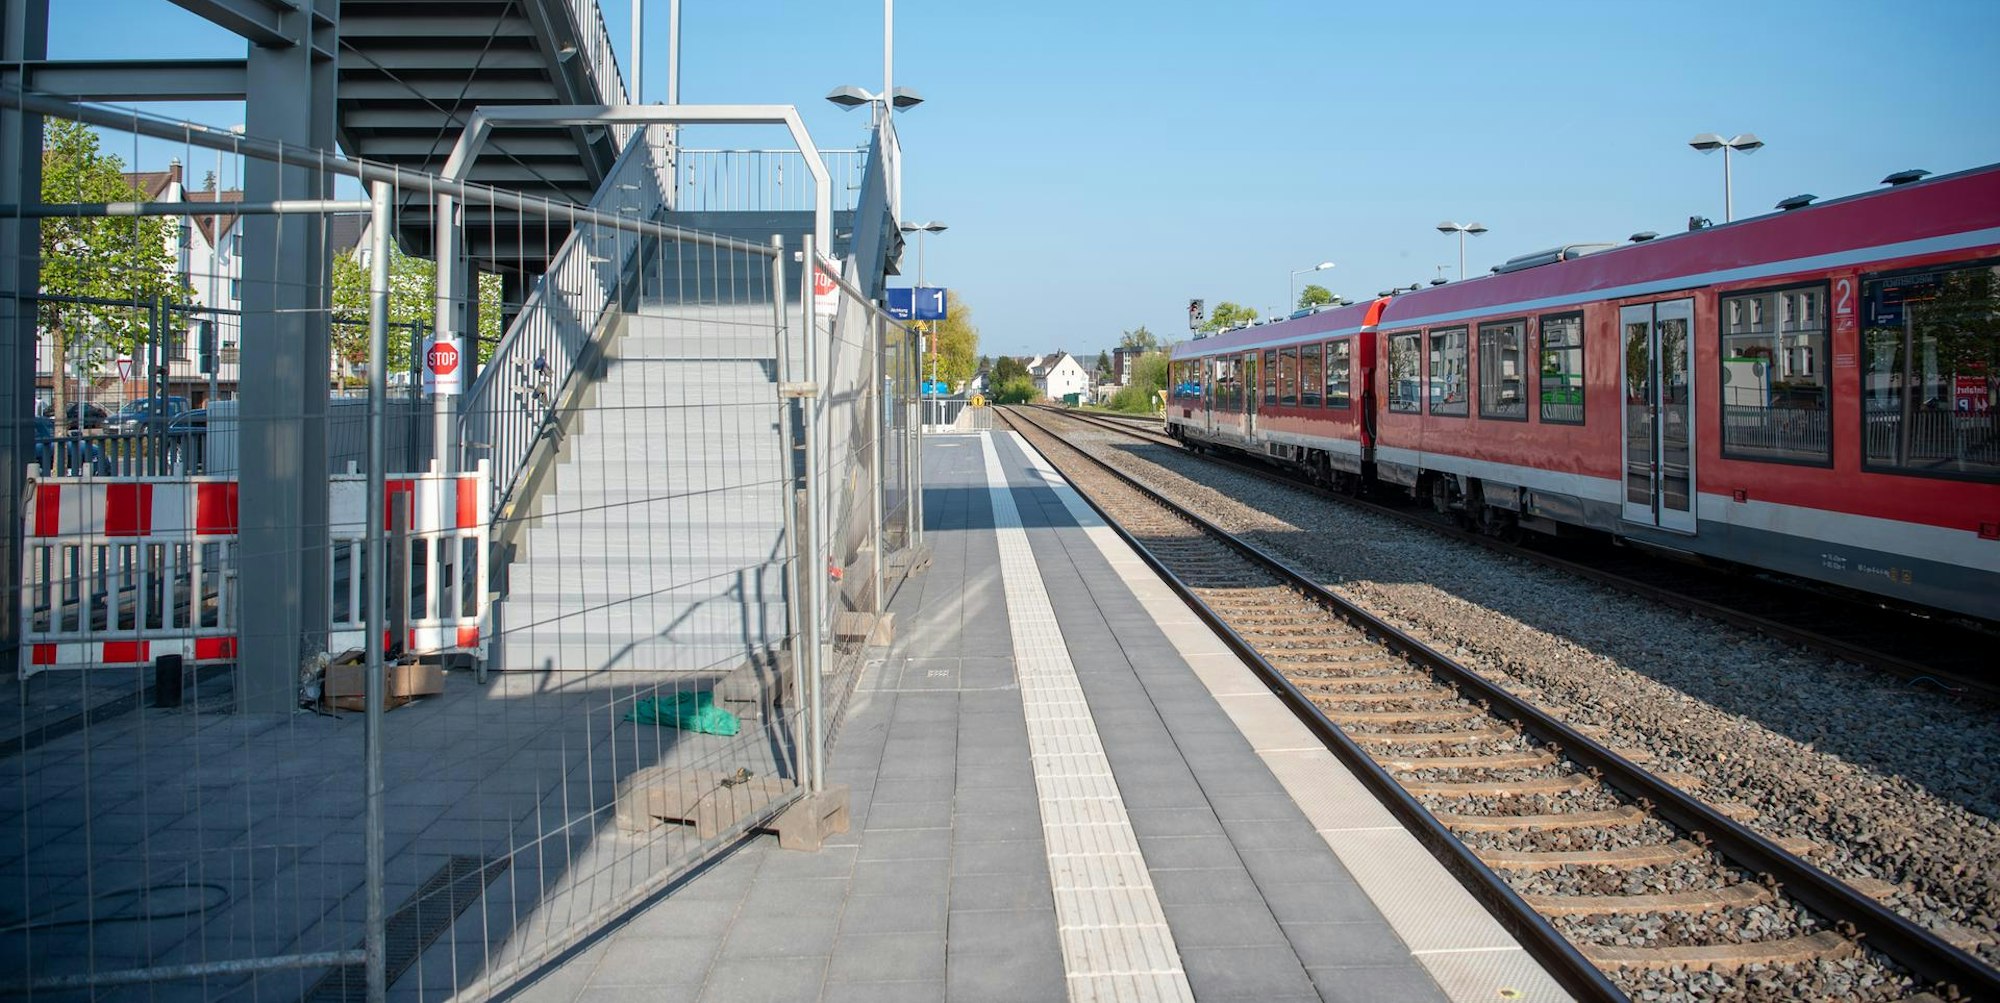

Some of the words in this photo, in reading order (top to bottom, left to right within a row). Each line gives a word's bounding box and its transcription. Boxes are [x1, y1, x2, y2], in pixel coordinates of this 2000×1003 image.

[933, 290, 943, 314] 1
[1836, 279, 1851, 314] 2
[1529, 317, 1537, 340] 2
[428, 351, 457, 366] STOP
